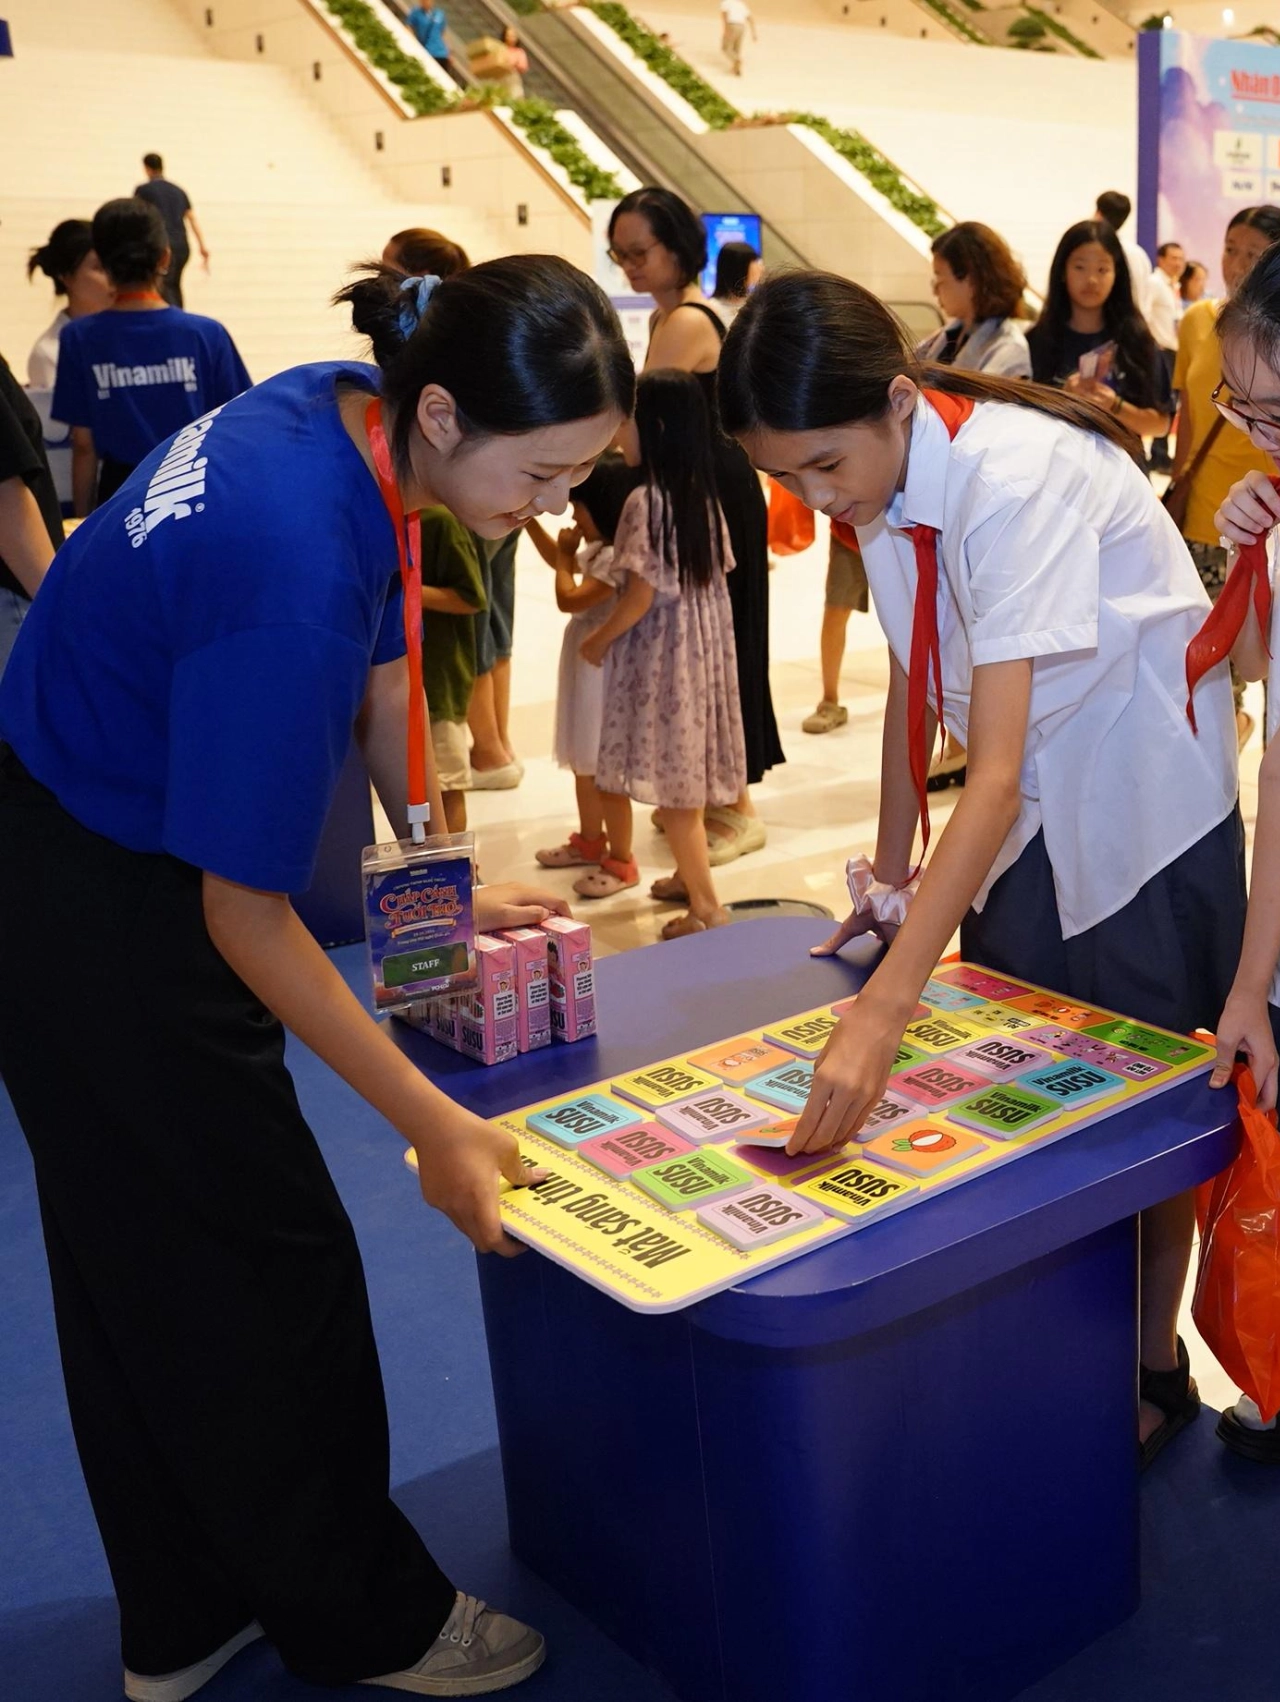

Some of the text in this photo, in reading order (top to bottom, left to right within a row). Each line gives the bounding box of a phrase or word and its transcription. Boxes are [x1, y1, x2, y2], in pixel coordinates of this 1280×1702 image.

[92, 357, 197, 388] Vinamilk
[124, 507, 148, 548] 1976
[411, 958, 440, 972] STAFF
[905, 1024, 961, 1047] SUSU
[965, 1050, 1011, 1071] Vinamilk
[976, 1041, 1035, 1064] SUSU
[630, 1075, 675, 1098] Vinamilk
[645, 1066, 705, 1091] SUSU
[915, 1067, 976, 1093] SUSU
[1032, 1065, 1086, 1086] Vinamilk
[1046, 1071, 1107, 1097] SUSU
[575, 1100, 621, 1125] Vinamilk
[693, 1096, 752, 1125] SUSU
[965, 1098, 1033, 1125] SUSU
[990, 1091, 1043, 1114] Vinamilk
[545, 1107, 606, 1134] SUSU
[678, 1106, 719, 1131] Vinamilk
[600, 1139, 643, 1167] Vinamilk
[615, 1130, 676, 1160] SUSU
[652, 1163, 715, 1195] SUSU
[686, 1156, 734, 1186] Vinamilk
[829, 1168, 901, 1198] SUSU
[817, 1180, 873, 1207] Vinamilk
[560, 1193, 642, 1235] sáng
[720, 1203, 769, 1235] Vinamilk
[737, 1193, 804, 1226] SUSU
